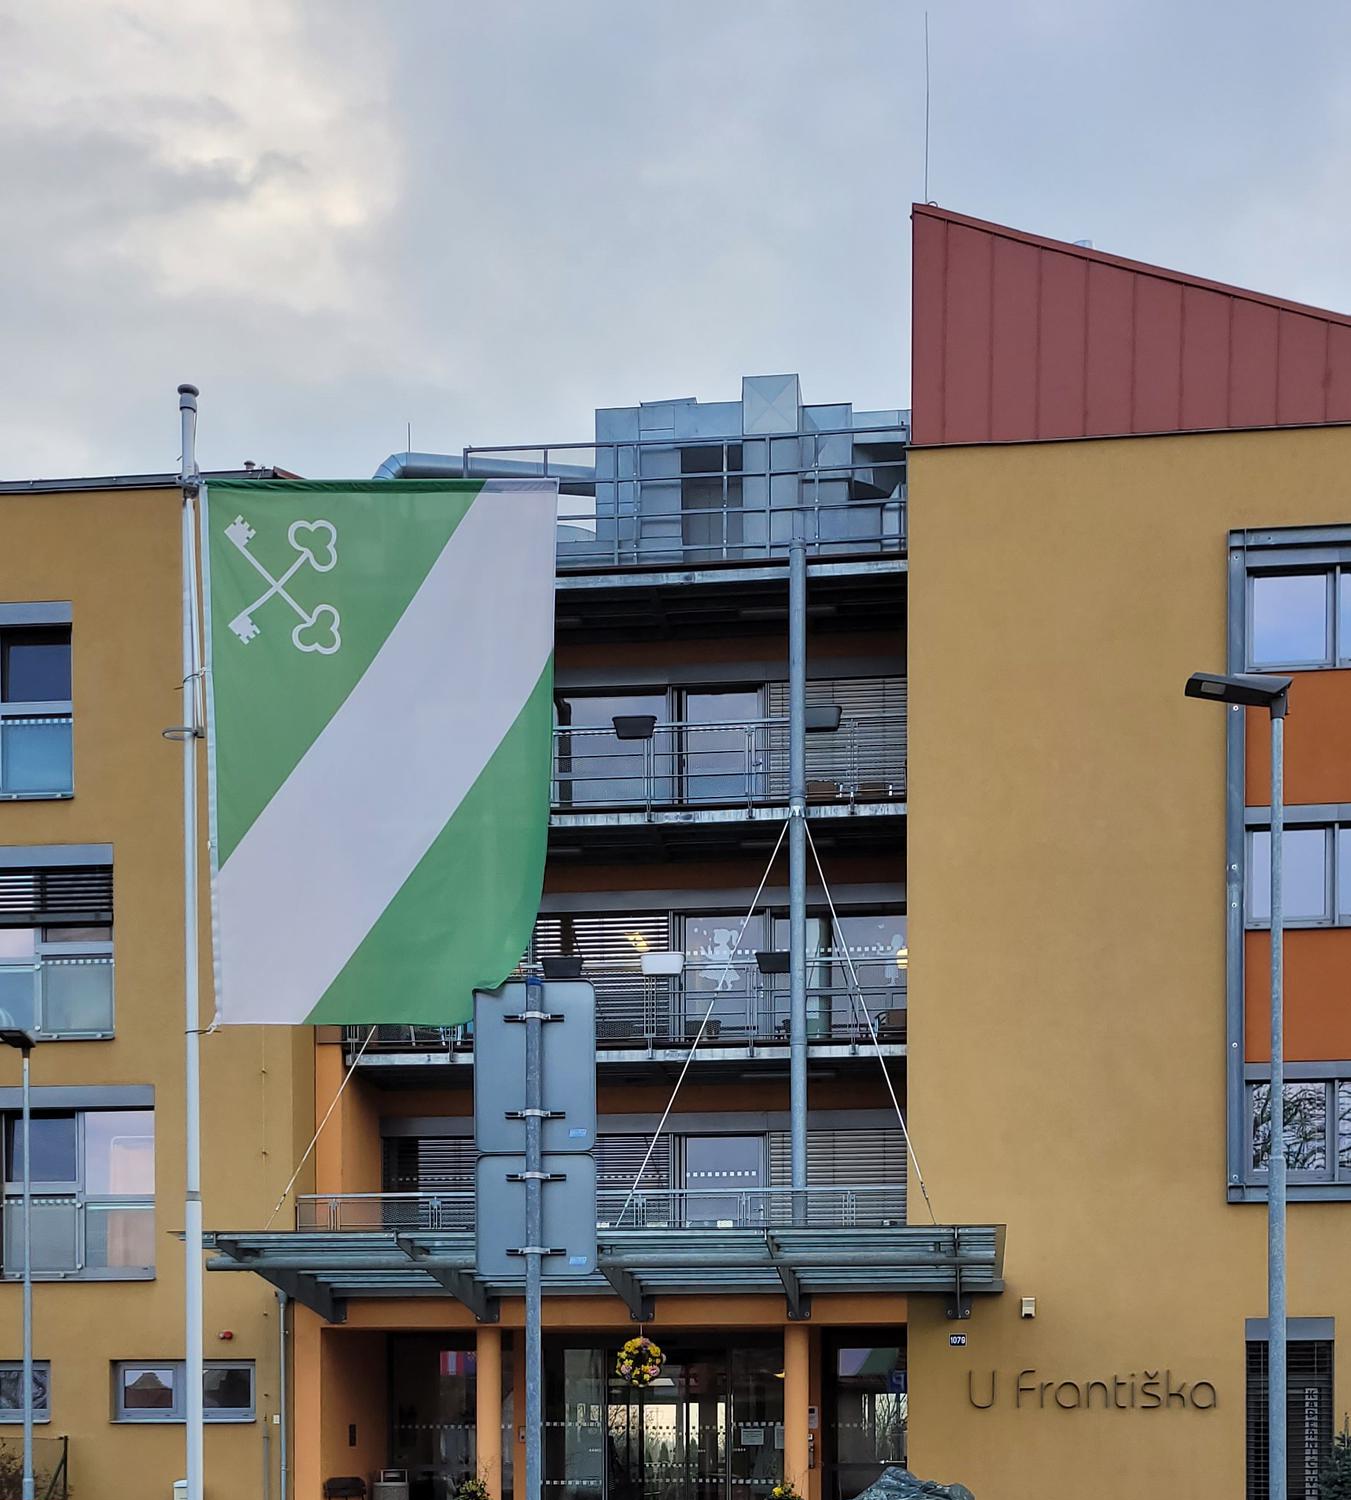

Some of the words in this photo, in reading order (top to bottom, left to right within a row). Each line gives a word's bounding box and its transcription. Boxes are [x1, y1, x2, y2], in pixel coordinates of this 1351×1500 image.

[950, 1336, 966, 1345] 1079
[968, 1370, 997, 1409] U
[1016, 1369, 1217, 1409] Františka
